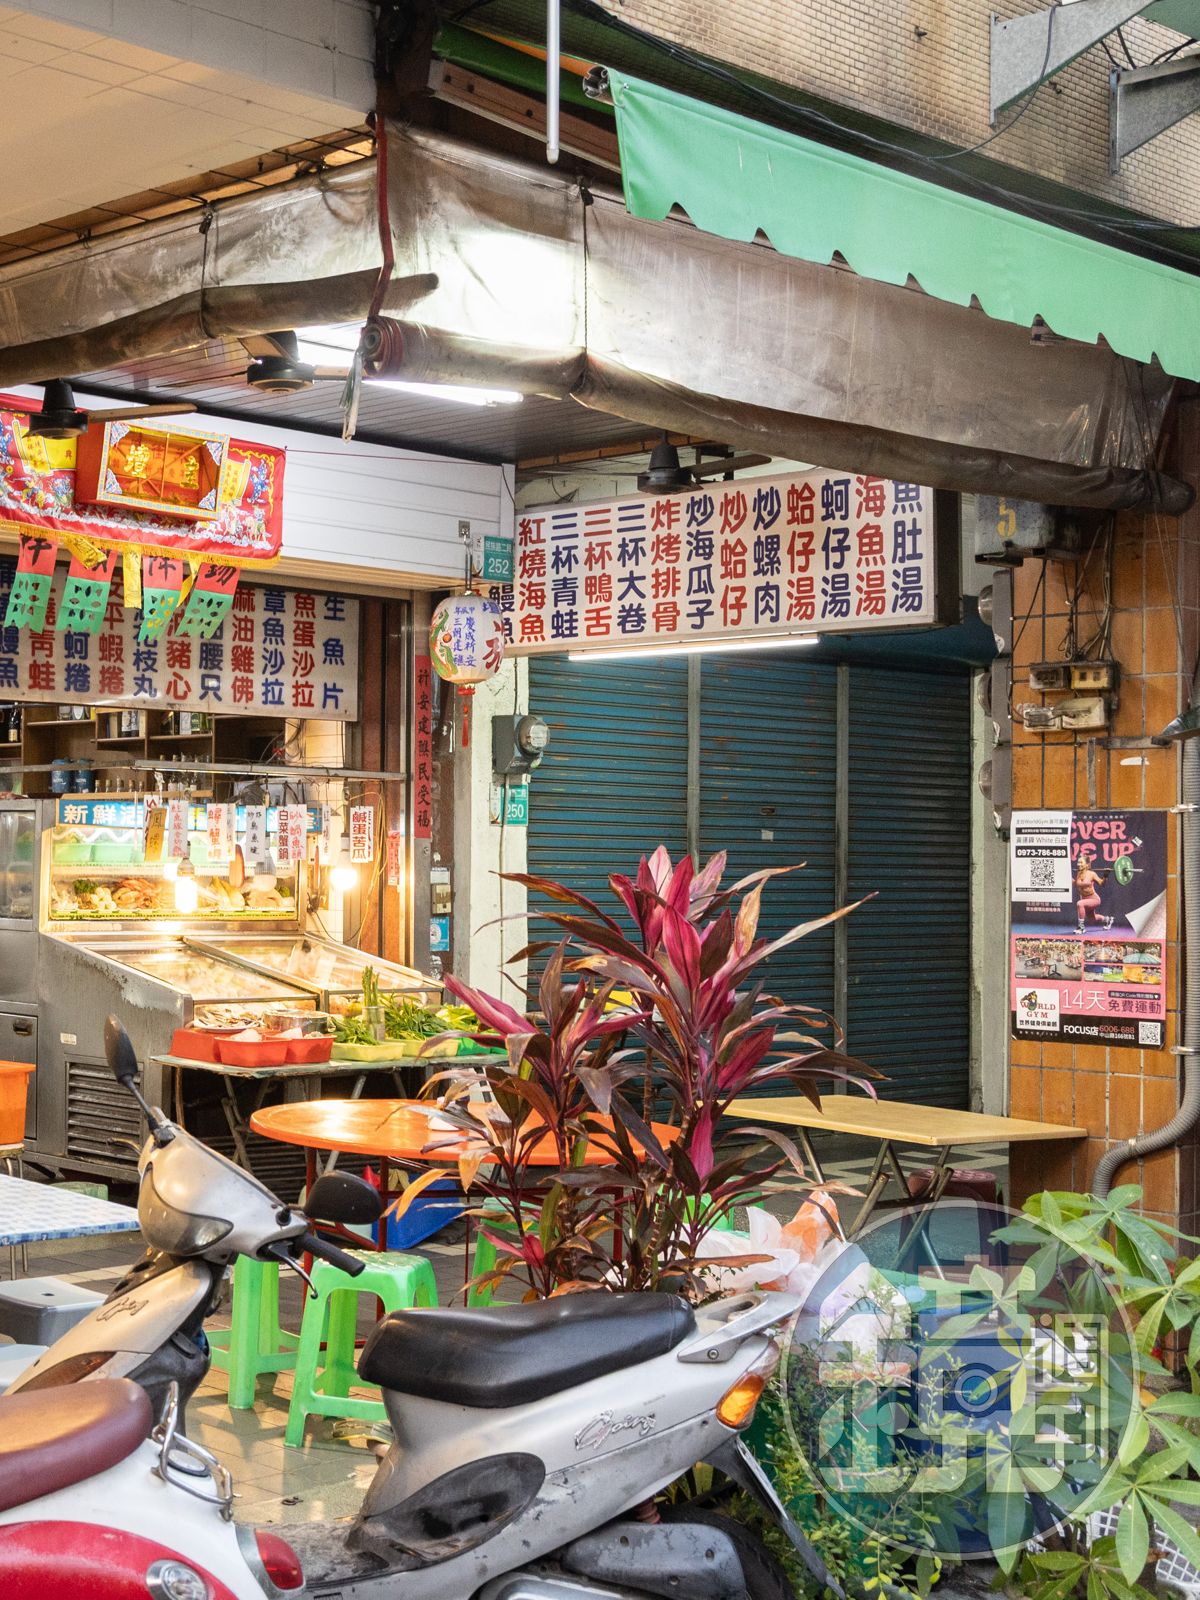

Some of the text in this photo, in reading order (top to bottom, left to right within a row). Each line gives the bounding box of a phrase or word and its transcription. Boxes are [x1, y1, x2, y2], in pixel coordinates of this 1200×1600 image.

[488, 558, 509, 574] 252
[518, 517, 548, 643] 紅燒海魚
[549, 512, 579, 639] 三杯青蛙
[583, 508, 614, 638] 三杯鴨舌
[616, 503, 647, 635] 三杯大卷
[650, 500, 683, 633] 炸烤排骨
[685, 495, 715, 630] 炒海瓜子
[719, 491, 748, 627] 炒蛤仔
[752, 485, 782, 624] 炒螺肉
[786, 482, 816, 622] 蛤仔湯
[820, 478, 851, 619] 蚵仔湯
[855, 475, 886, 617] 海魚湯
[891, 480, 923, 613] 魚肚湯
[231, 588, 255, 703] 麻油雞佛
[261, 590, 286, 705] 章魚沙拉
[292, 592, 316, 708] 魚蛋沙拉
[322, 595, 346, 709] 生魚片
[279, 809, 289, 860] 白菜蟹鍋
[352, 811, 367, 859] 鹹蛋苦瓜
[507, 803, 524, 818] 250
[1017, 849, 1067, 857] 0973-786-889
[1071, 820, 1127, 840] EVER
[1102, 842, 1135, 862] UP
[1026, 1011, 1048, 1019] GYM
[1062, 989, 1106, 1011] 14天
[1108, 999, 1161, 1014] 免費運動
